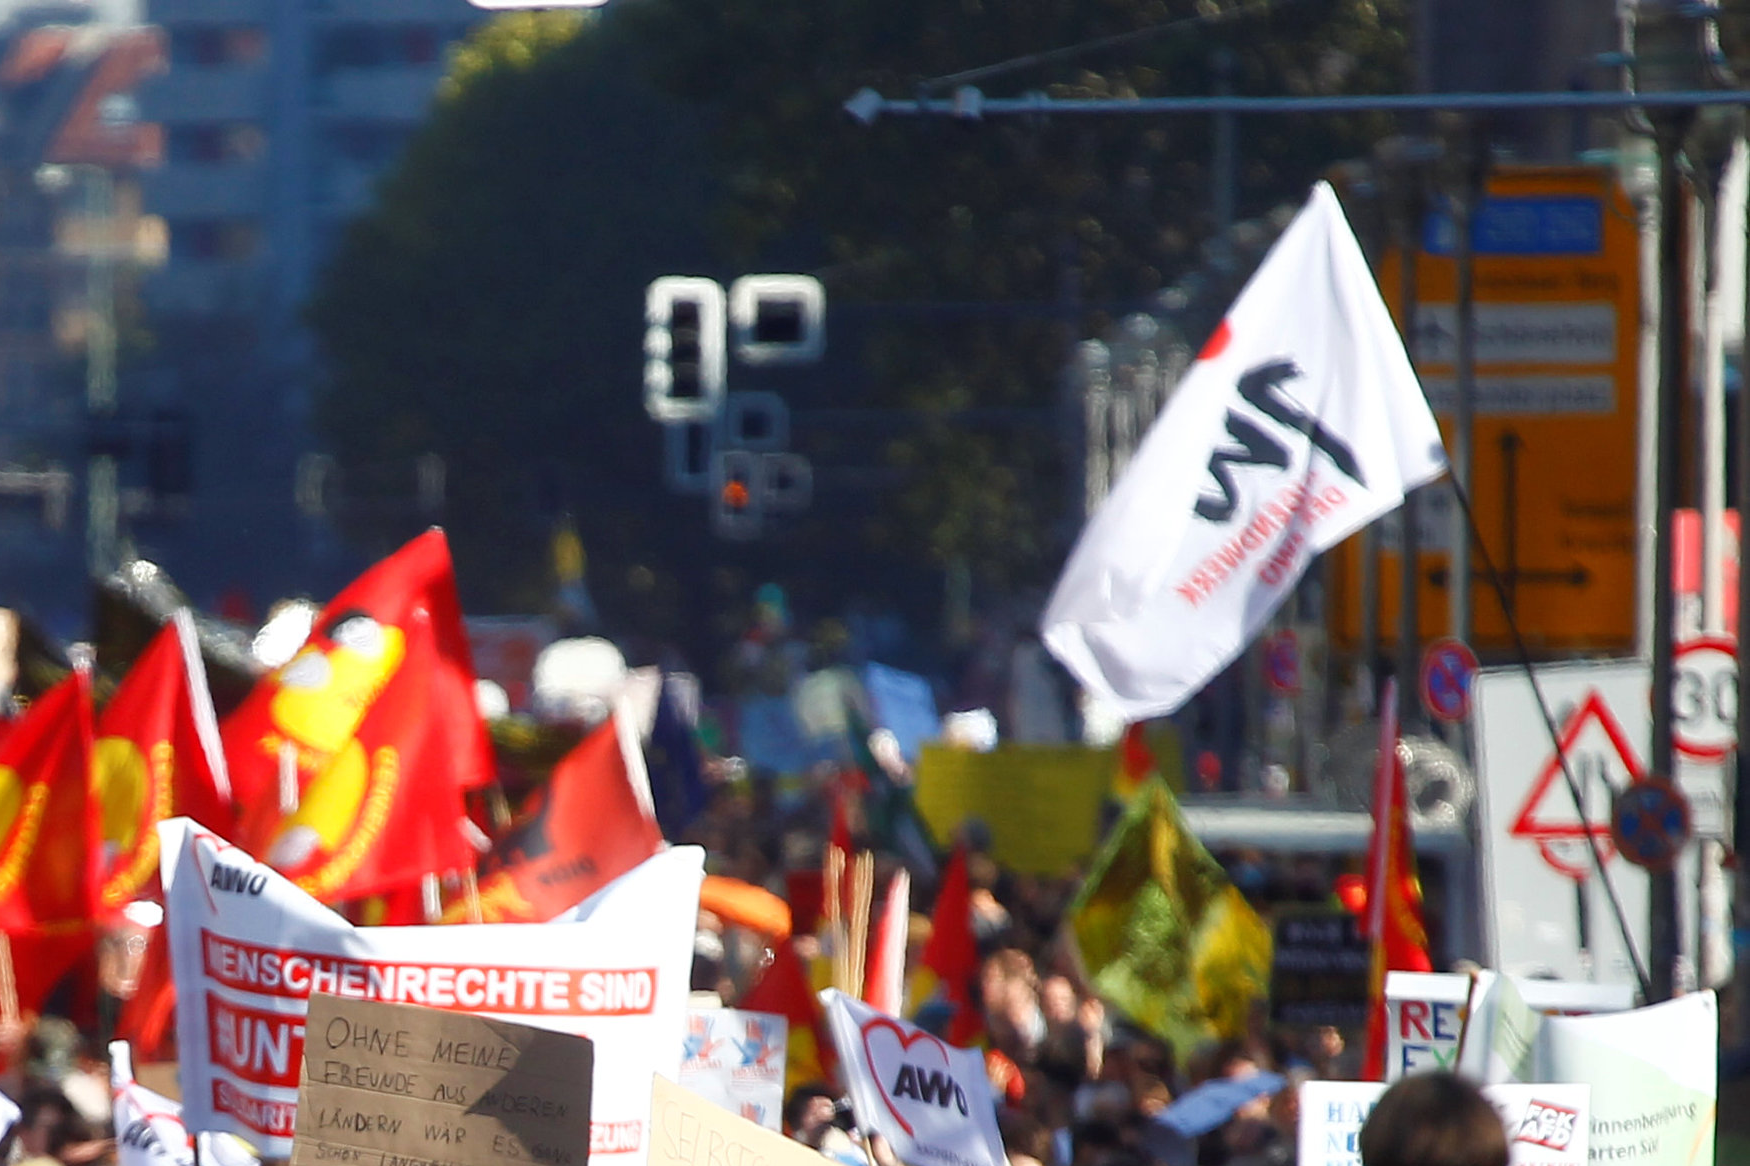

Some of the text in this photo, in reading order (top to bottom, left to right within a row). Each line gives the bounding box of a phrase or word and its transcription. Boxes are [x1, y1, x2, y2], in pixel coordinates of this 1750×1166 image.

[211, 862, 268, 897] AWO
[577, 970, 652, 1013] SIND
[1401, 1000, 1466, 1041] RE
[215, 1008, 305, 1077] #UN
[325, 1016, 515, 1071] OHNE MEINE
[324, 1061, 418, 1095] FREUNDE
[433, 1083, 467, 1104] AUS
[893, 1062, 969, 1119] AWO
[319, 1108, 402, 1134] LÄNDERN
[424, 1121, 467, 1144] WÄR
[492, 1134, 521, 1158] ES
[591, 1121, 642, 1152] ZUNG
[1516, 1119, 1570, 1146] AFD
[1525, 1103, 1576, 1132] FCK
[1588, 1143, 1637, 1161] arten
